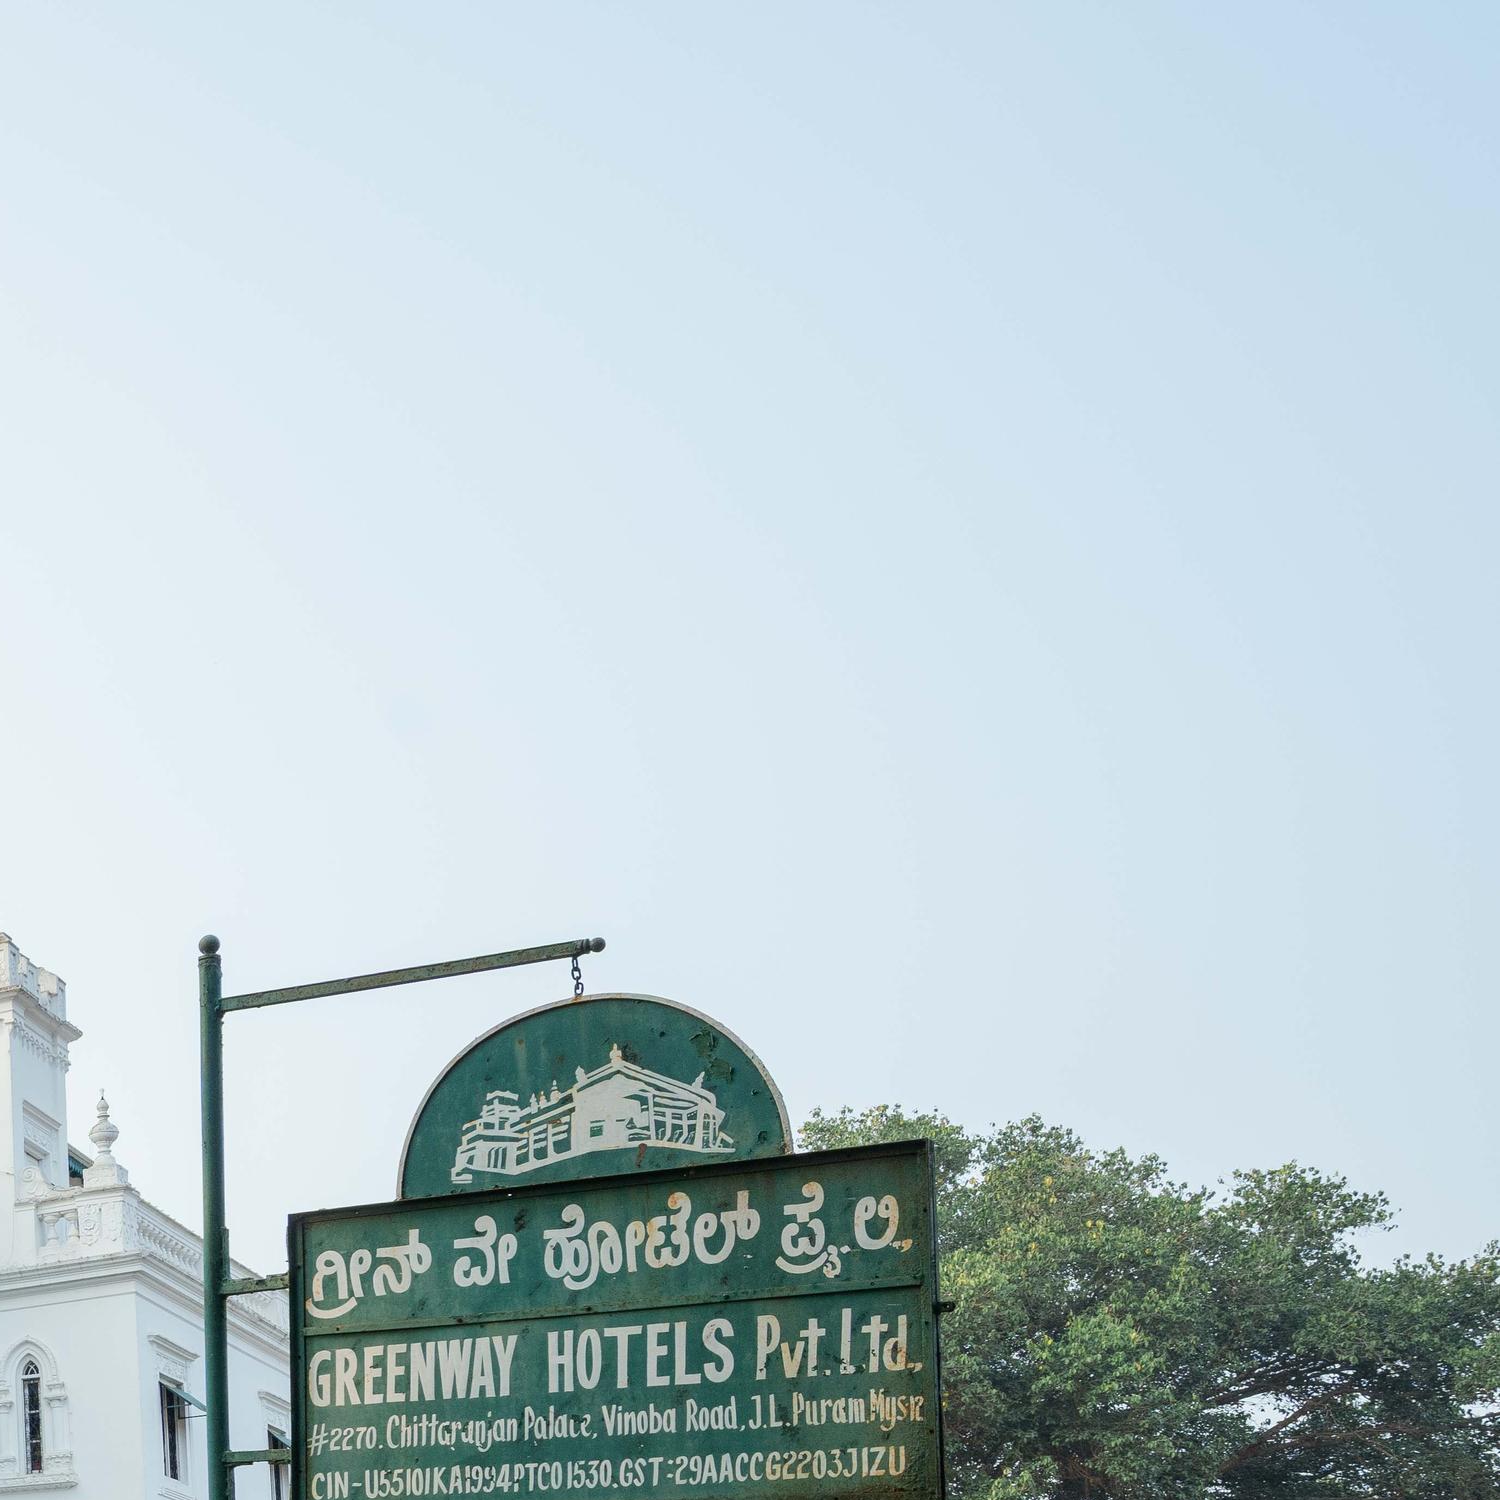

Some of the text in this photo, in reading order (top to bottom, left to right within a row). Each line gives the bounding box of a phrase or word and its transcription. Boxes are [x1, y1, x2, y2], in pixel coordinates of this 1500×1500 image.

[306, 1229, 432, 1319] ಗ್ರೀನ್
[454, 1215, 518, 1287] ವೇ
[543, 1190, 760, 1290] ಹೋಟೆಲ್
[309, 1335, 518, 1407] GREENWAY
[547, 1318, 735, 1393] HOTELS
[386, 1411, 518, 1452] Chittaranjan
[524, 1405, 598, 1440] Palace,
[602, 1403, 677, 1436] Vinoba
[686, 1396, 745, 1432] Road,
